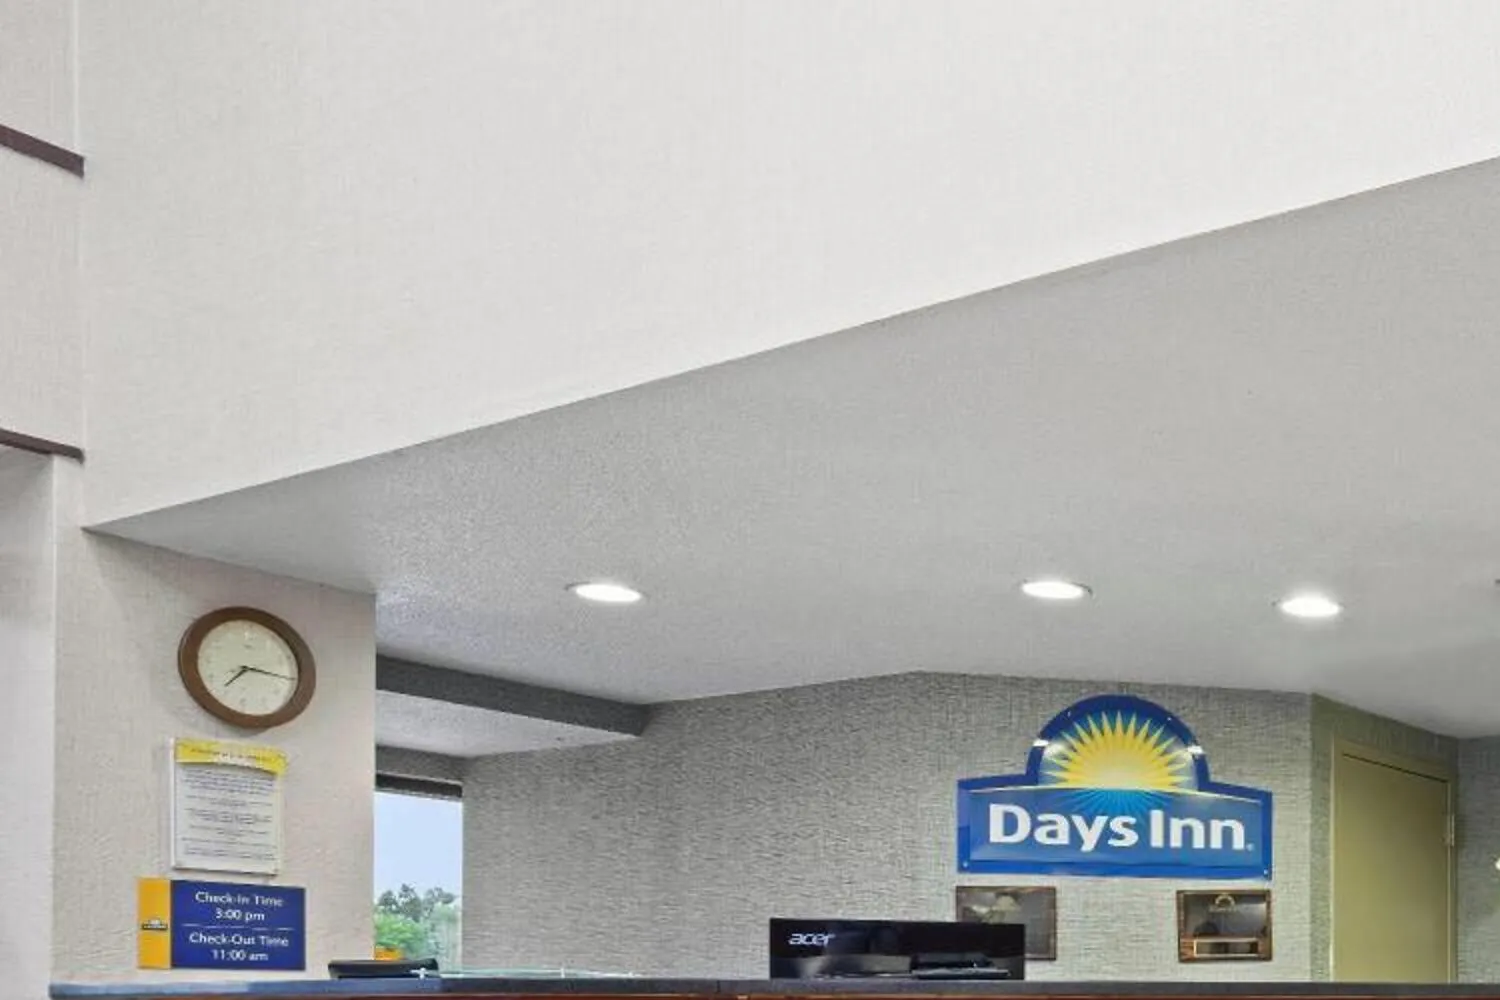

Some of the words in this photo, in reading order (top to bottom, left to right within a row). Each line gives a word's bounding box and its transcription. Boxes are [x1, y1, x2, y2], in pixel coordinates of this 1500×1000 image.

[989, 803, 1139, 852] Days
[1150, 809, 1245, 850] Inn
[255, 895, 284, 907] Time
[215, 909, 241, 920] 3:00
[245, 912, 265, 922] pm
[189, 932, 256, 945] Check-Out
[259, 935, 289, 948] Time
[788, 932, 834, 945] acer
[212, 949, 246, 961] 11:00
[249, 952, 269, 961] am
